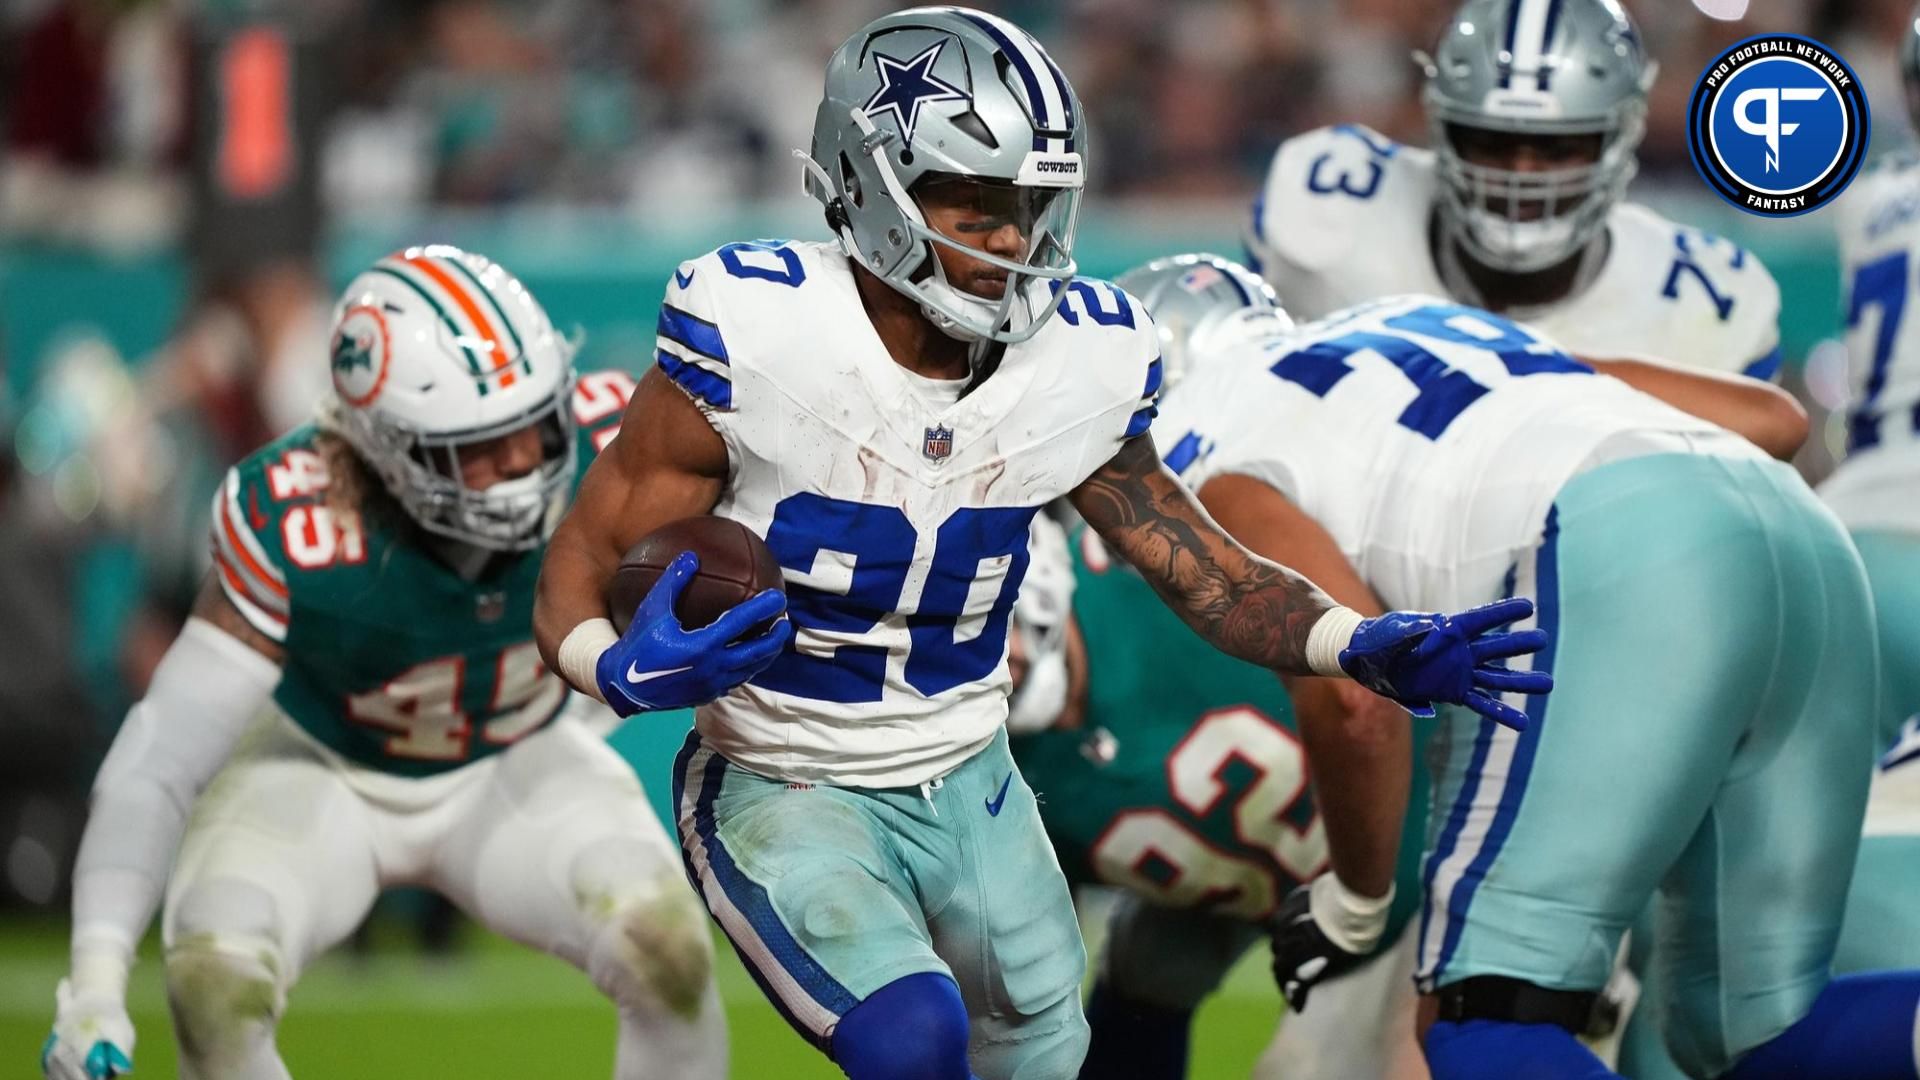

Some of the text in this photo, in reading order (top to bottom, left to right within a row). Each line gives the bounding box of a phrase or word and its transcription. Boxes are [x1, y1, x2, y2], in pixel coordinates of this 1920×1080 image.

[1037, 161, 1078, 174] COWBOYS
[265, 448, 368, 569] 45
[745, 490, 1044, 704] 20
[346, 641, 566, 762] 45
[1089, 704, 1331, 918] 92
